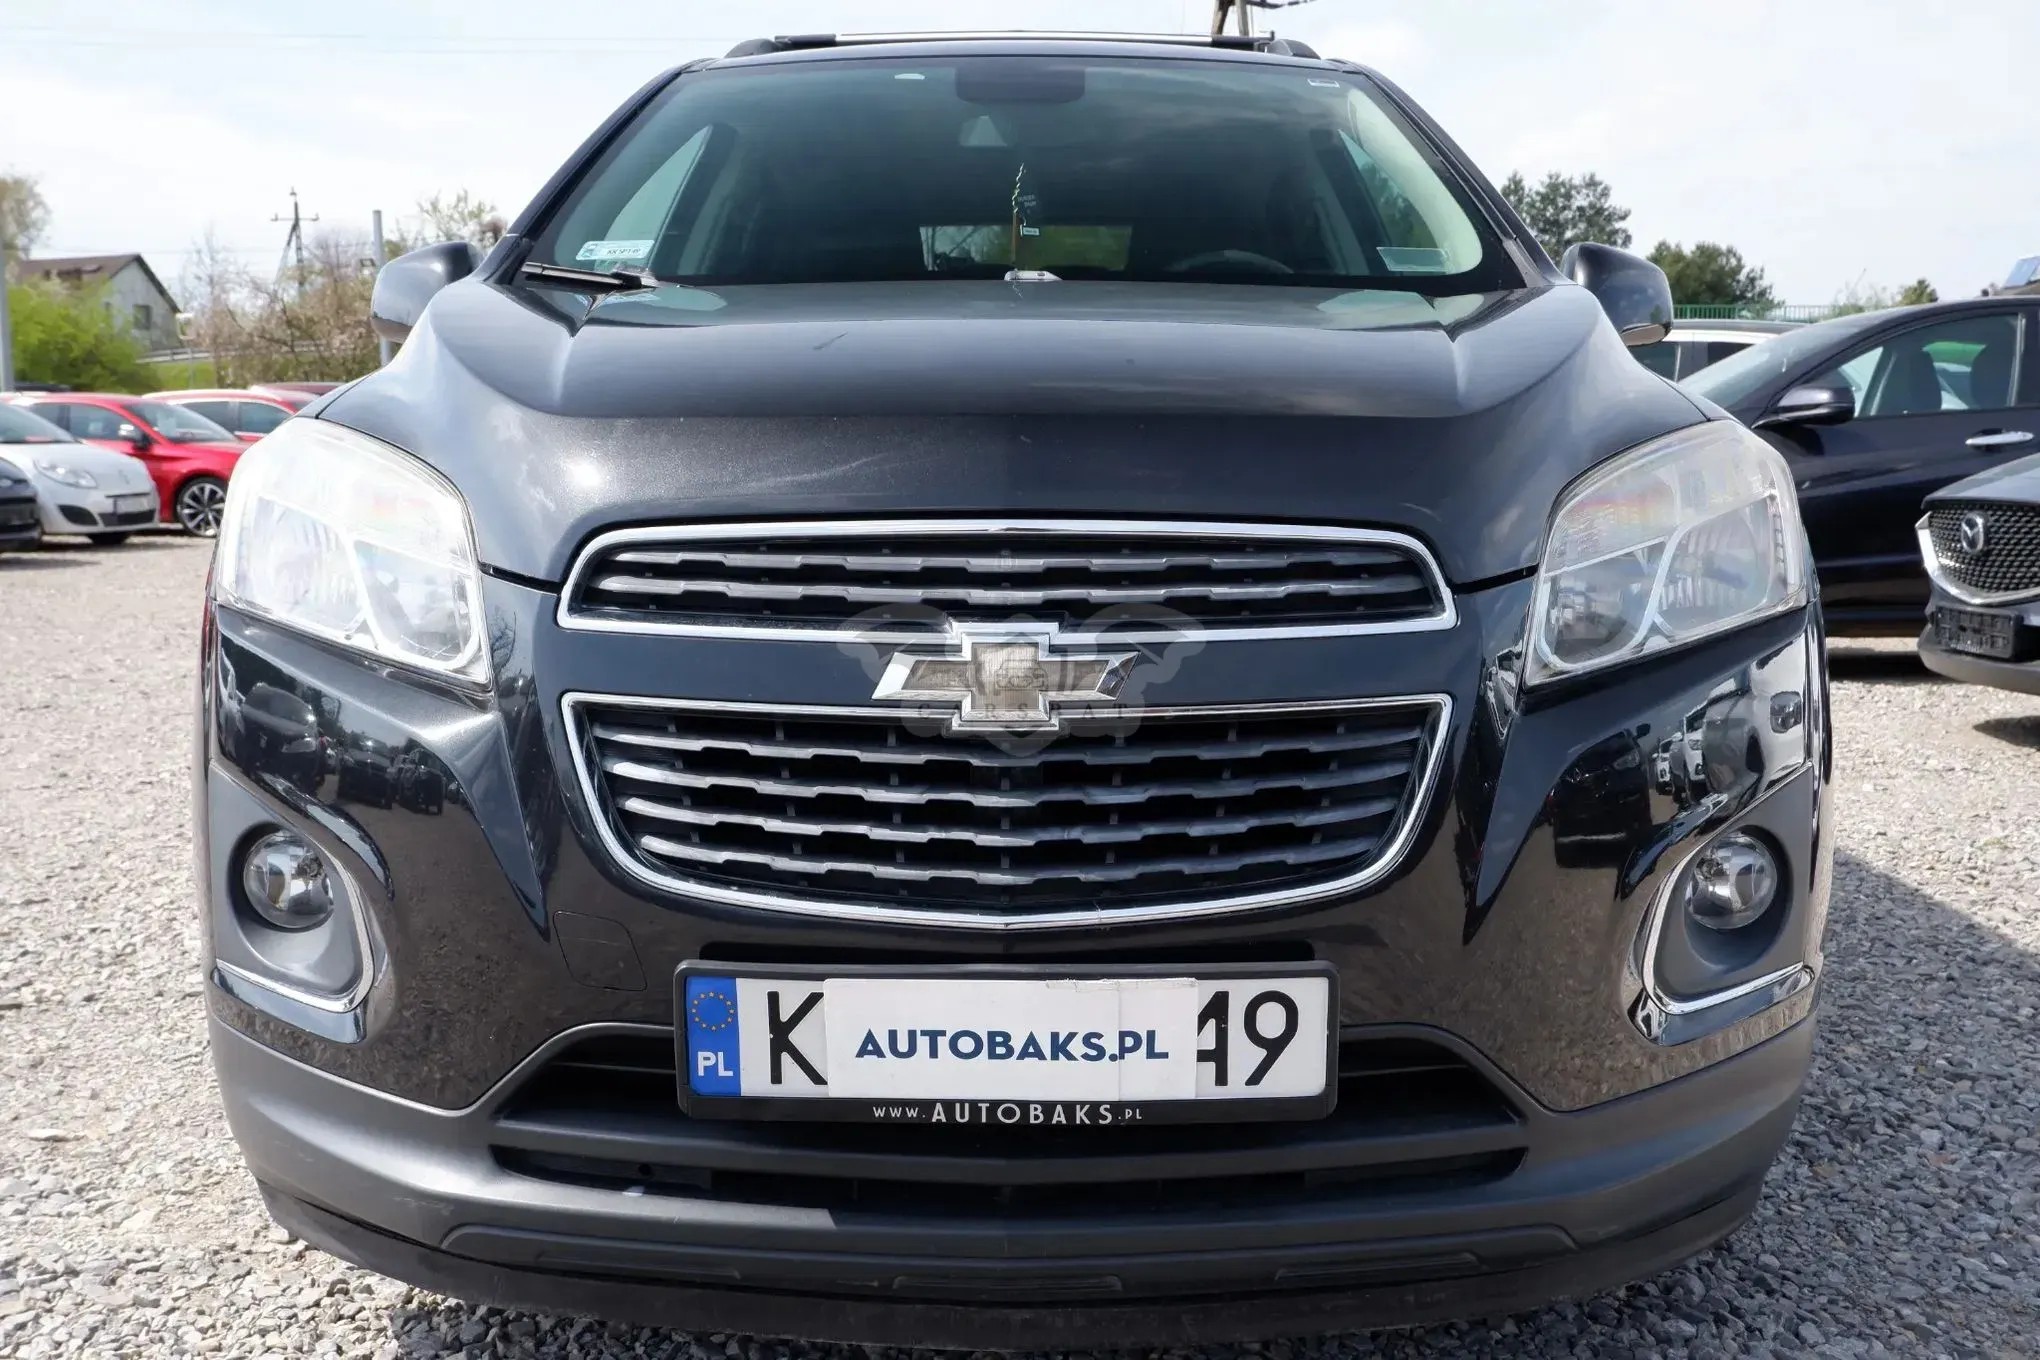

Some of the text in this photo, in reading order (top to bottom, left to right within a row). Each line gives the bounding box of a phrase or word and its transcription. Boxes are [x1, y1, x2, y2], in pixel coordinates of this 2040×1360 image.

[767, 991, 828, 1085] K
[854, 1028, 1170, 1063] AUTOBAKS.PL
[697, 1051, 734, 1077] PL
